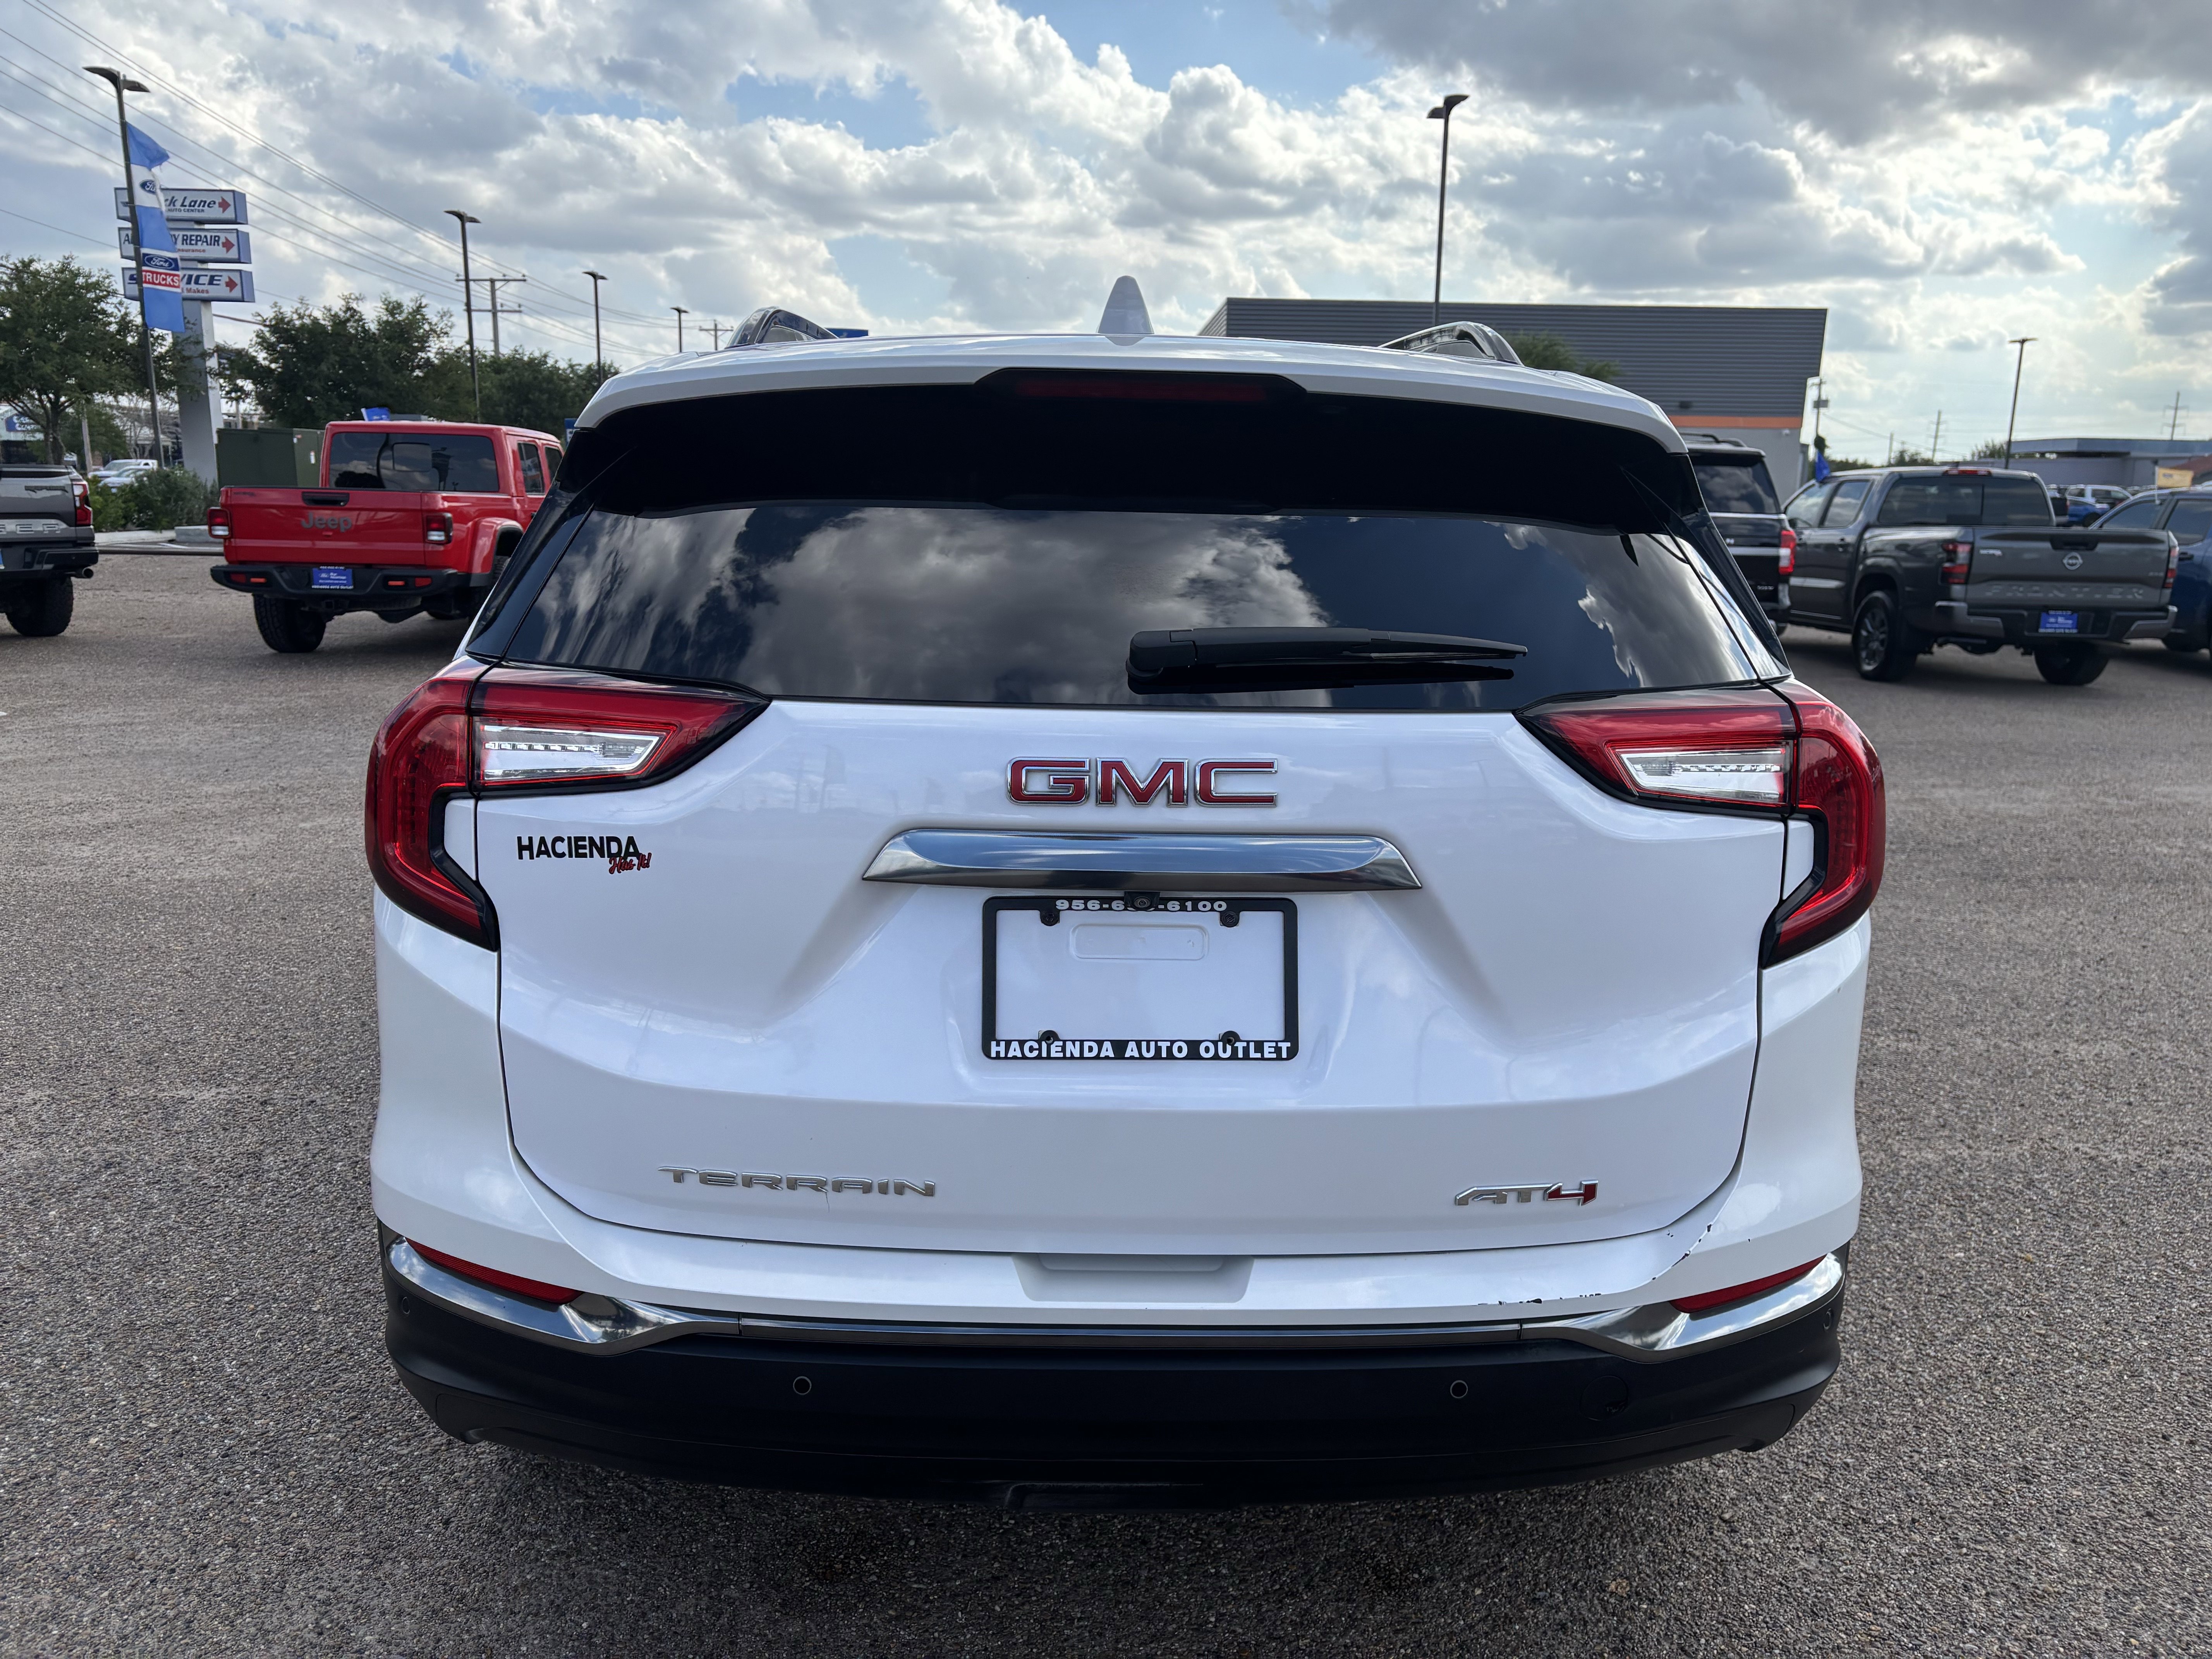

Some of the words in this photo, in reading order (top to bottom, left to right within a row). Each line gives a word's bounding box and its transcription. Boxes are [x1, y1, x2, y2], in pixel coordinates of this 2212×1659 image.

[180, 196, 216, 208] Lane
[181, 234, 220, 246] REPAIR
[151, 256, 169, 267] Ford
[142, 271, 180, 286] TRUCKS
[301, 512, 352, 533] Jeep
[1006, 757, 1277, 807] GMC
[517, 836, 640, 860] HACIENDA
[609, 857, 636, 874] Has
[1056, 900, 1227, 912] 956-6-6100
[991, 1041, 1115, 1058] HACIENDA
[1124, 1041, 1188, 1058] AUTO
[1199, 1041, 1291, 1058] OUTLET
[658, 1166, 935, 1197] TERRAIN
[1455, 1180, 1599, 1206] AT4
